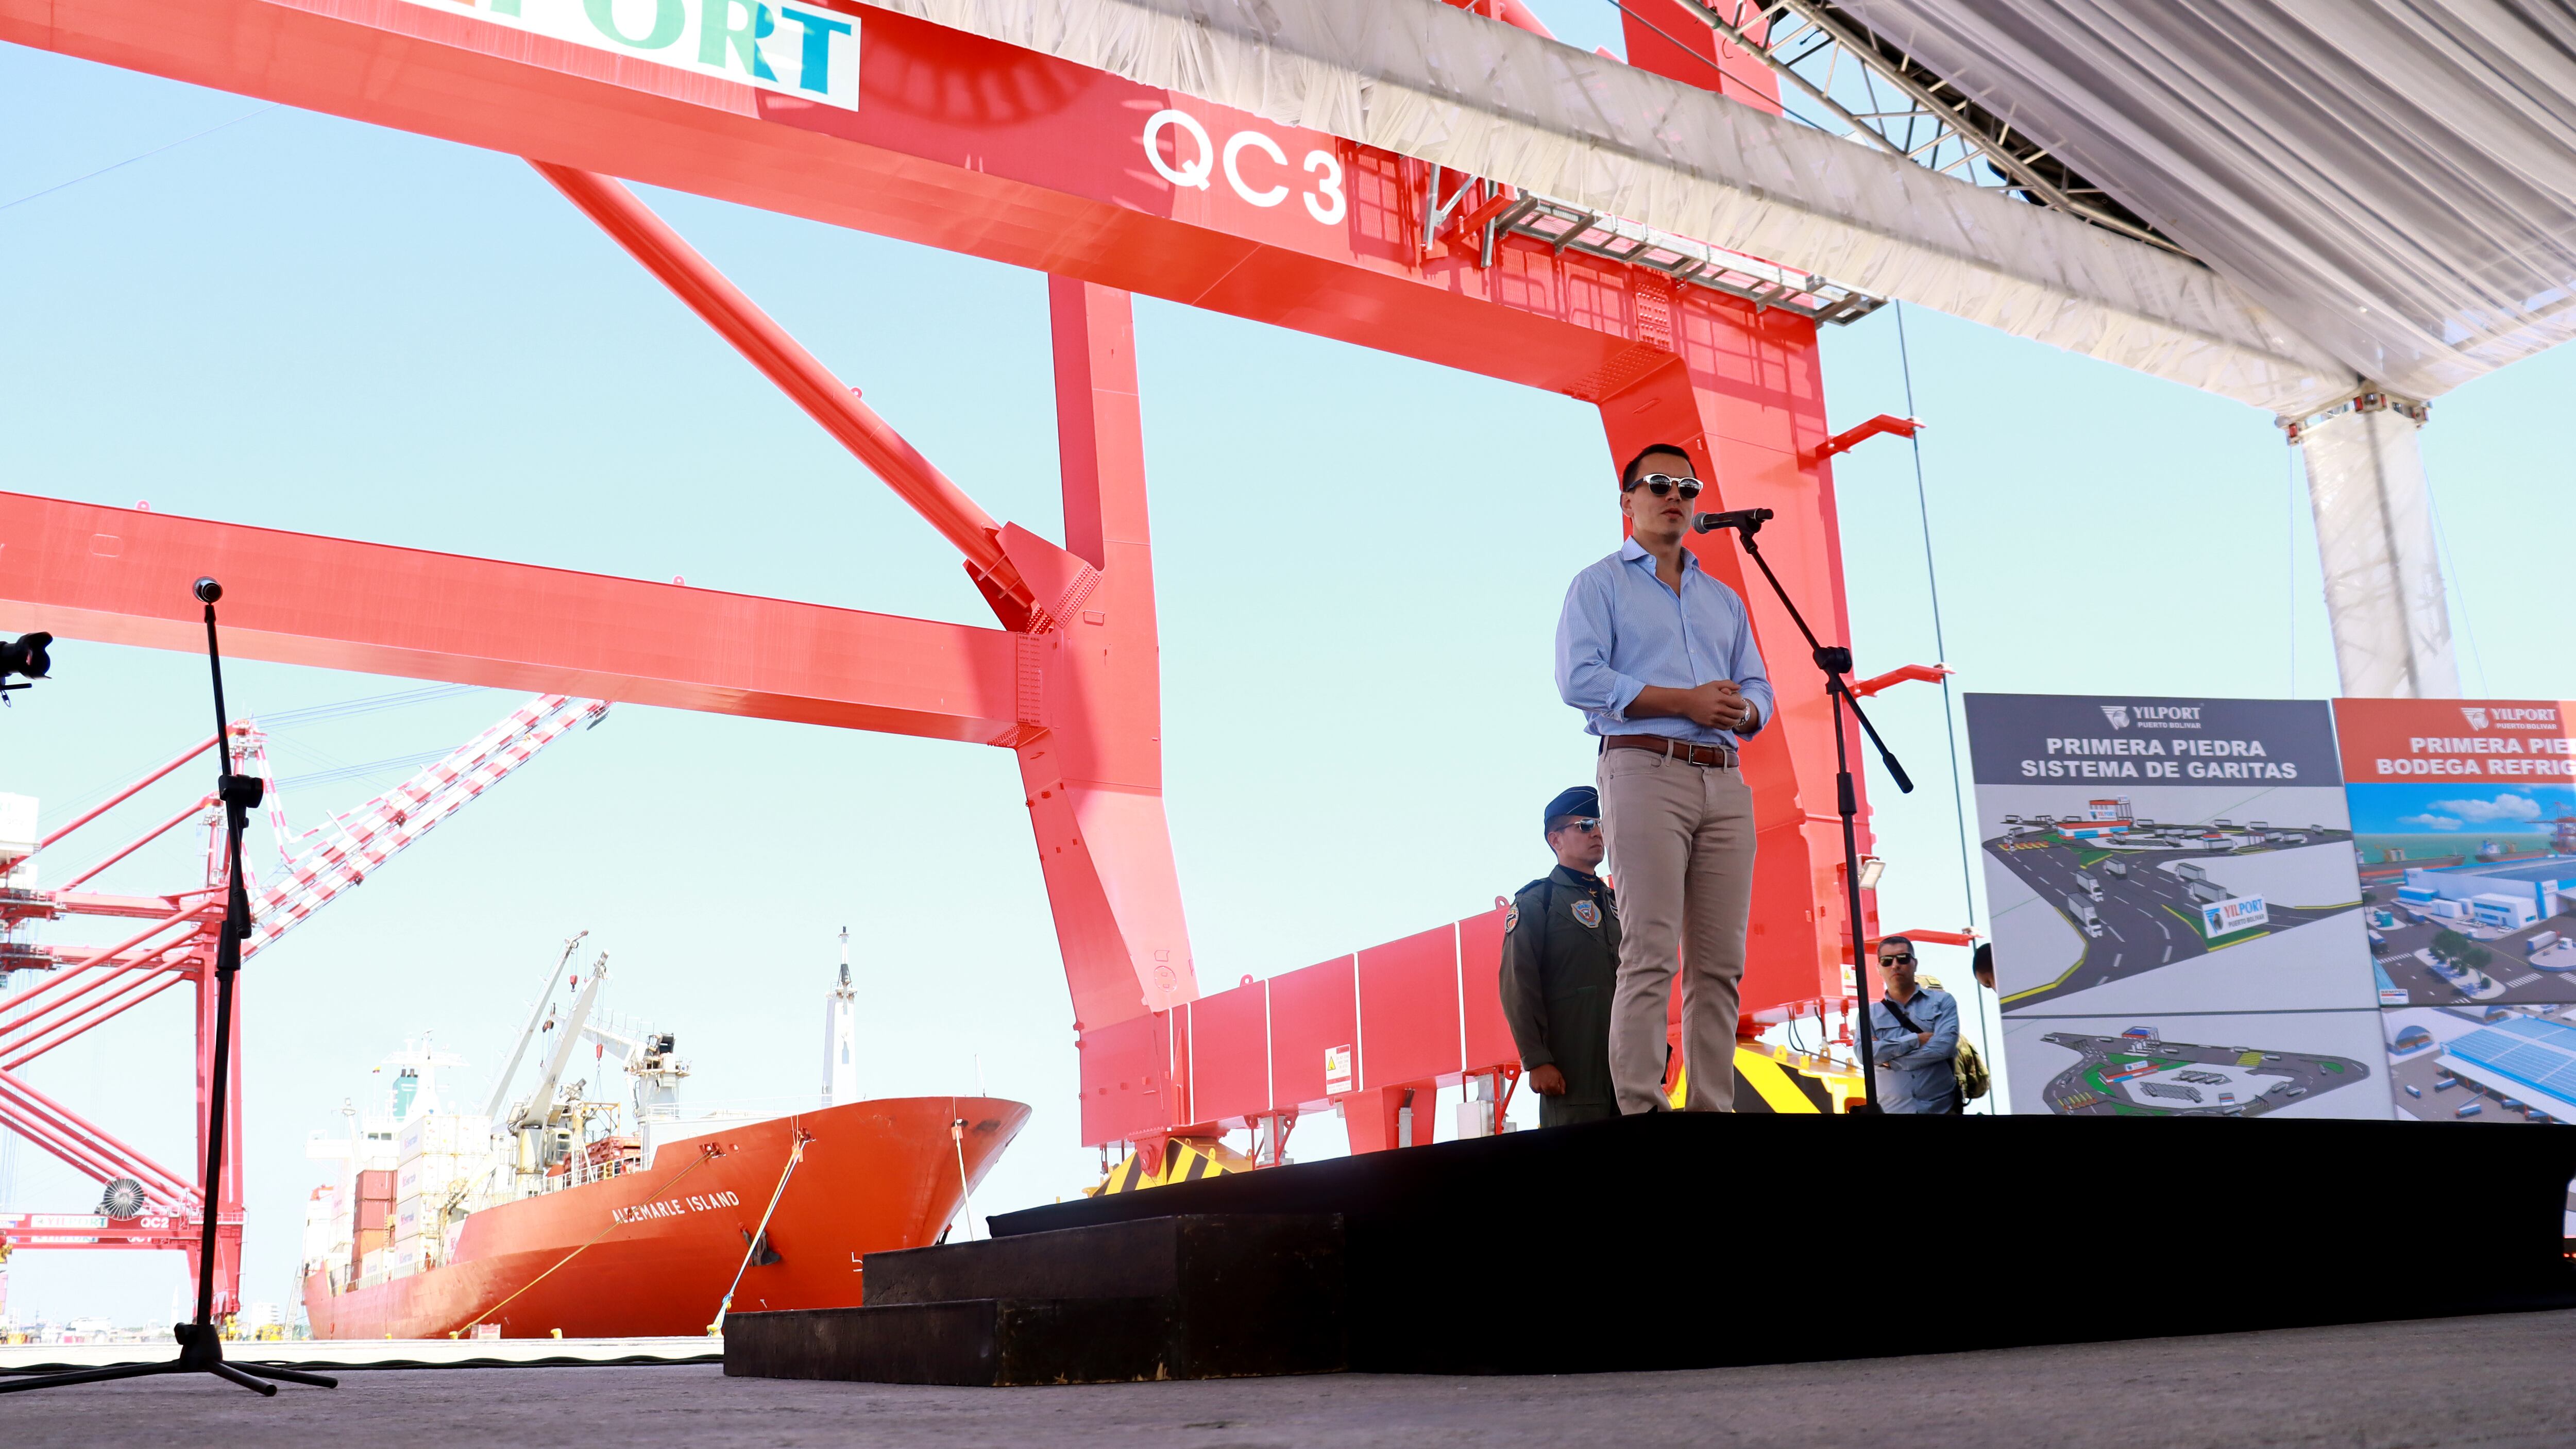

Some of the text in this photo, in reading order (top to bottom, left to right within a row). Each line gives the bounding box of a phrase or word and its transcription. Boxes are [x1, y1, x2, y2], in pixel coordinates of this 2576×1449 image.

[1142, 109, 1347, 226] QC3
[2133, 706, 2200, 719] YILPORT
[2490, 708, 2556, 721] YILPORT
[2046, 738, 2266, 756] PRIMERA PIEDRA
[2411, 737, 2576, 754] PRIMERA PIE
[2021, 760, 2297, 779] SISTEMA DE GARITAS
[2377, 759, 2576, 775] BODEGA REFRIG
[2224, 899, 2263, 918] YILPORT
[2228, 918, 2246, 928] PUERTO
[686, 1191, 739, 1212] ISLAND
[140, 1217, 169, 1228] QC2
